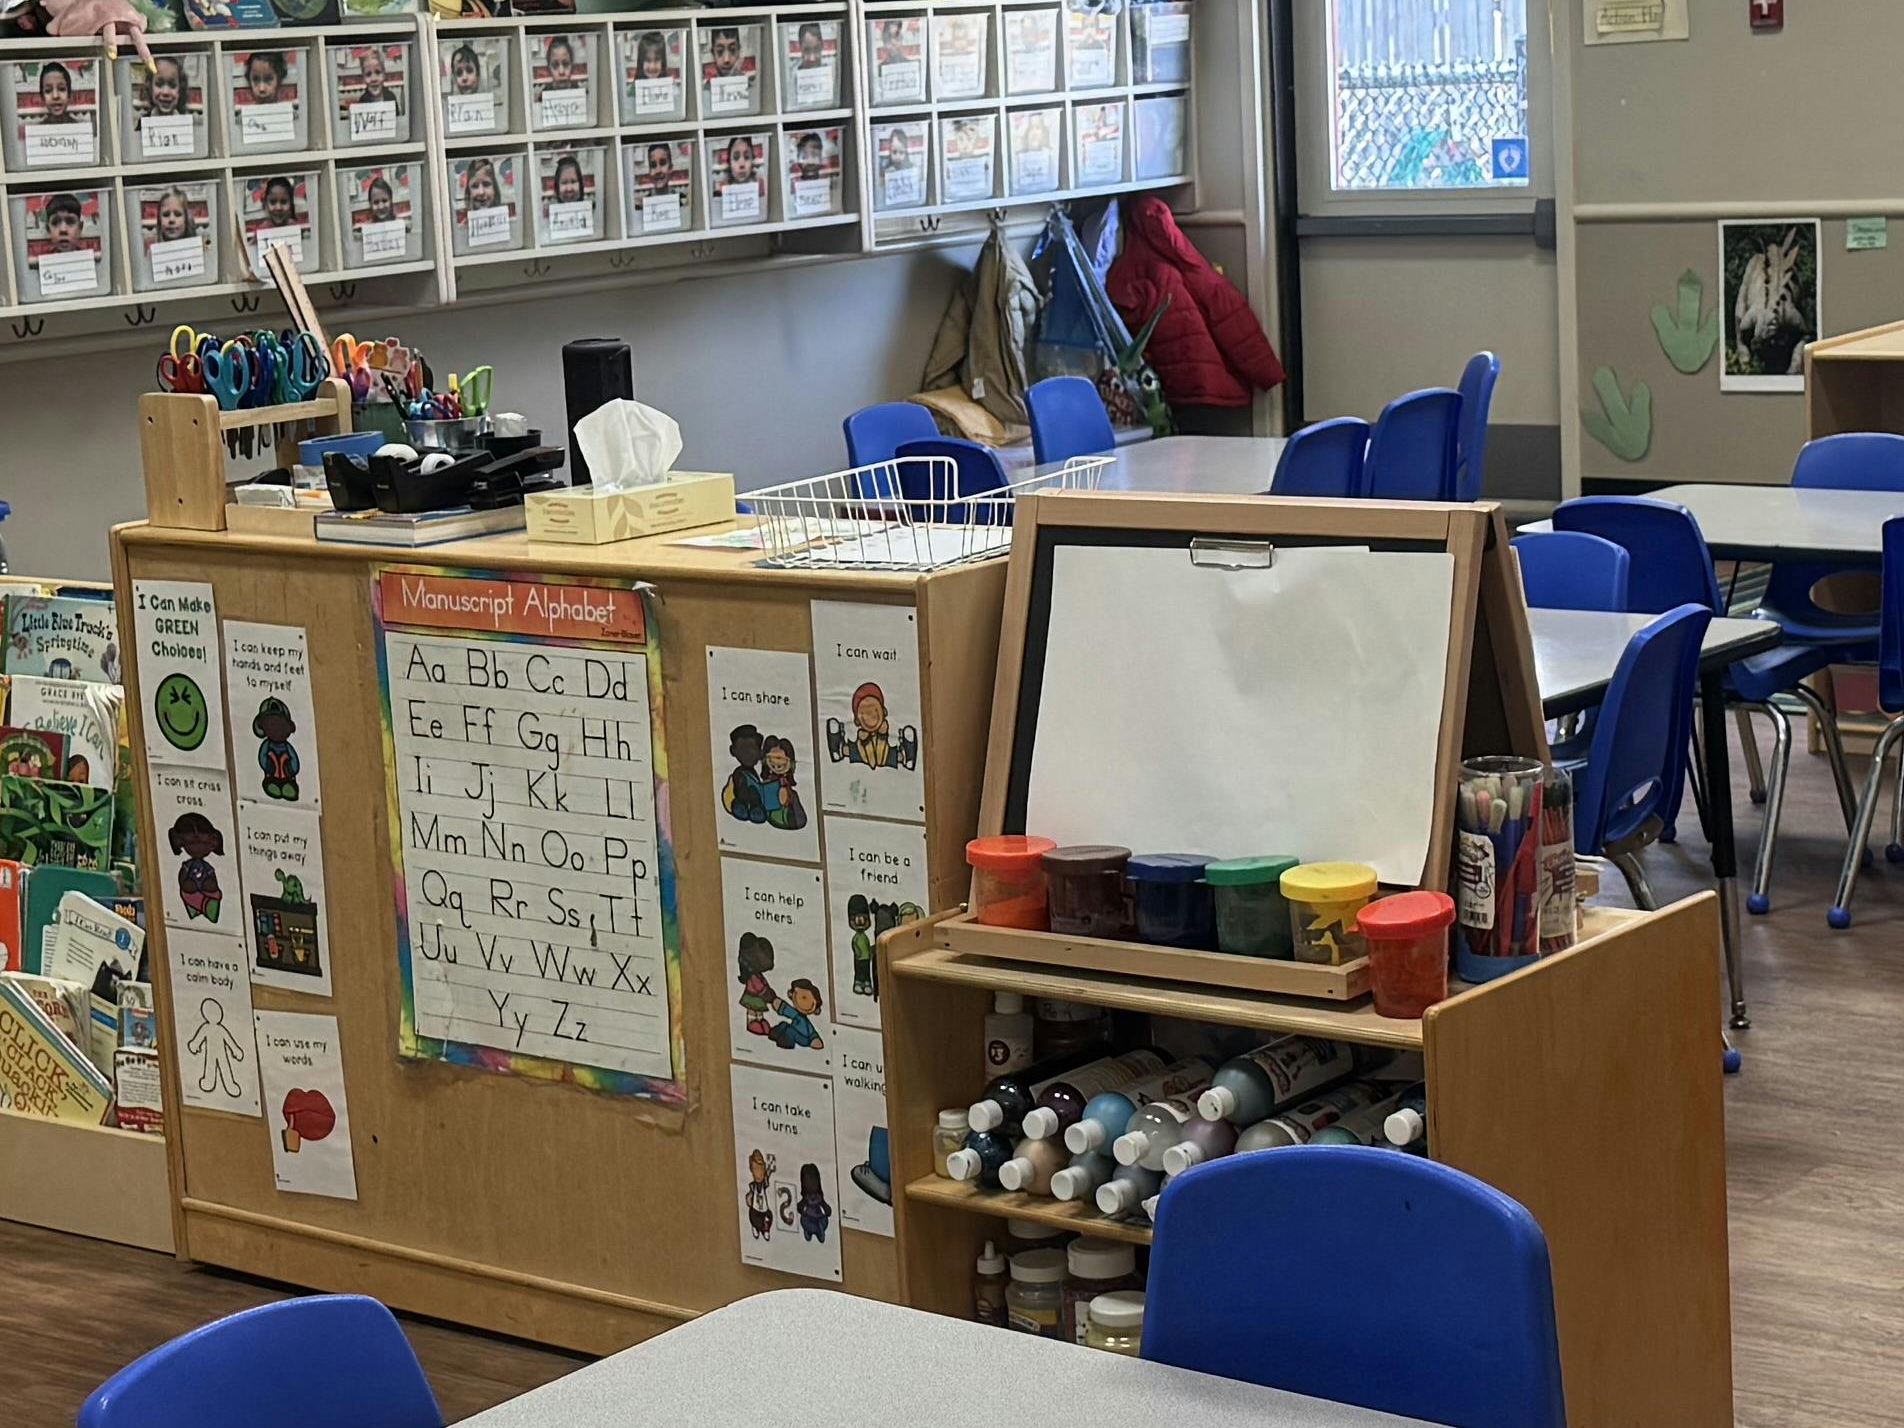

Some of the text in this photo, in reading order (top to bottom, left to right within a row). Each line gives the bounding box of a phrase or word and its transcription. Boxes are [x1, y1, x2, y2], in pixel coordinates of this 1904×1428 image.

[138, 594, 212, 614] I Can Make
[401, 578, 618, 634] Manuscript Alphabet
[21, 611, 114, 641] Little Blue Truck's
[155, 618, 200, 636] GREEN
[36, 635, 95, 659] Springtime
[151, 641, 208, 663] Choices!
[241, 643, 304, 661] can keep my
[836, 643, 869, 659] I can
[232, 656, 305, 676] hands and feet
[407, 644, 628, 702] Aa Bb Cc Dd
[246, 675, 257, 688] to
[721, 687, 728, 700] I
[731, 691, 753, 703] can
[408, 699, 631, 770] Ee Ff Gg Hh
[164, 777, 221, 792] can criss
[414, 755, 635, 820] Ii Jj Kk Ll
[253, 831, 308, 850] can put my
[249, 844, 278, 861] things
[412, 811, 647, 895] Mm Nn Oo Pp
[849, 847, 911, 867] I can be a
[422, 870, 642, 938] Qq Rr Ss Tt
[744, 886, 804, 908] I can help
[188, 957, 229, 970] can have
[418, 923, 653, 996] Uu Vv Ww Xx
[186, 973, 209, 985] calm
[488, 989, 589, 1048] Yy Zz
[273, 1039, 328, 1055] can use my
[842, 1054, 872, 1072] I can
[752, 1096, 811, 1119] I can take
